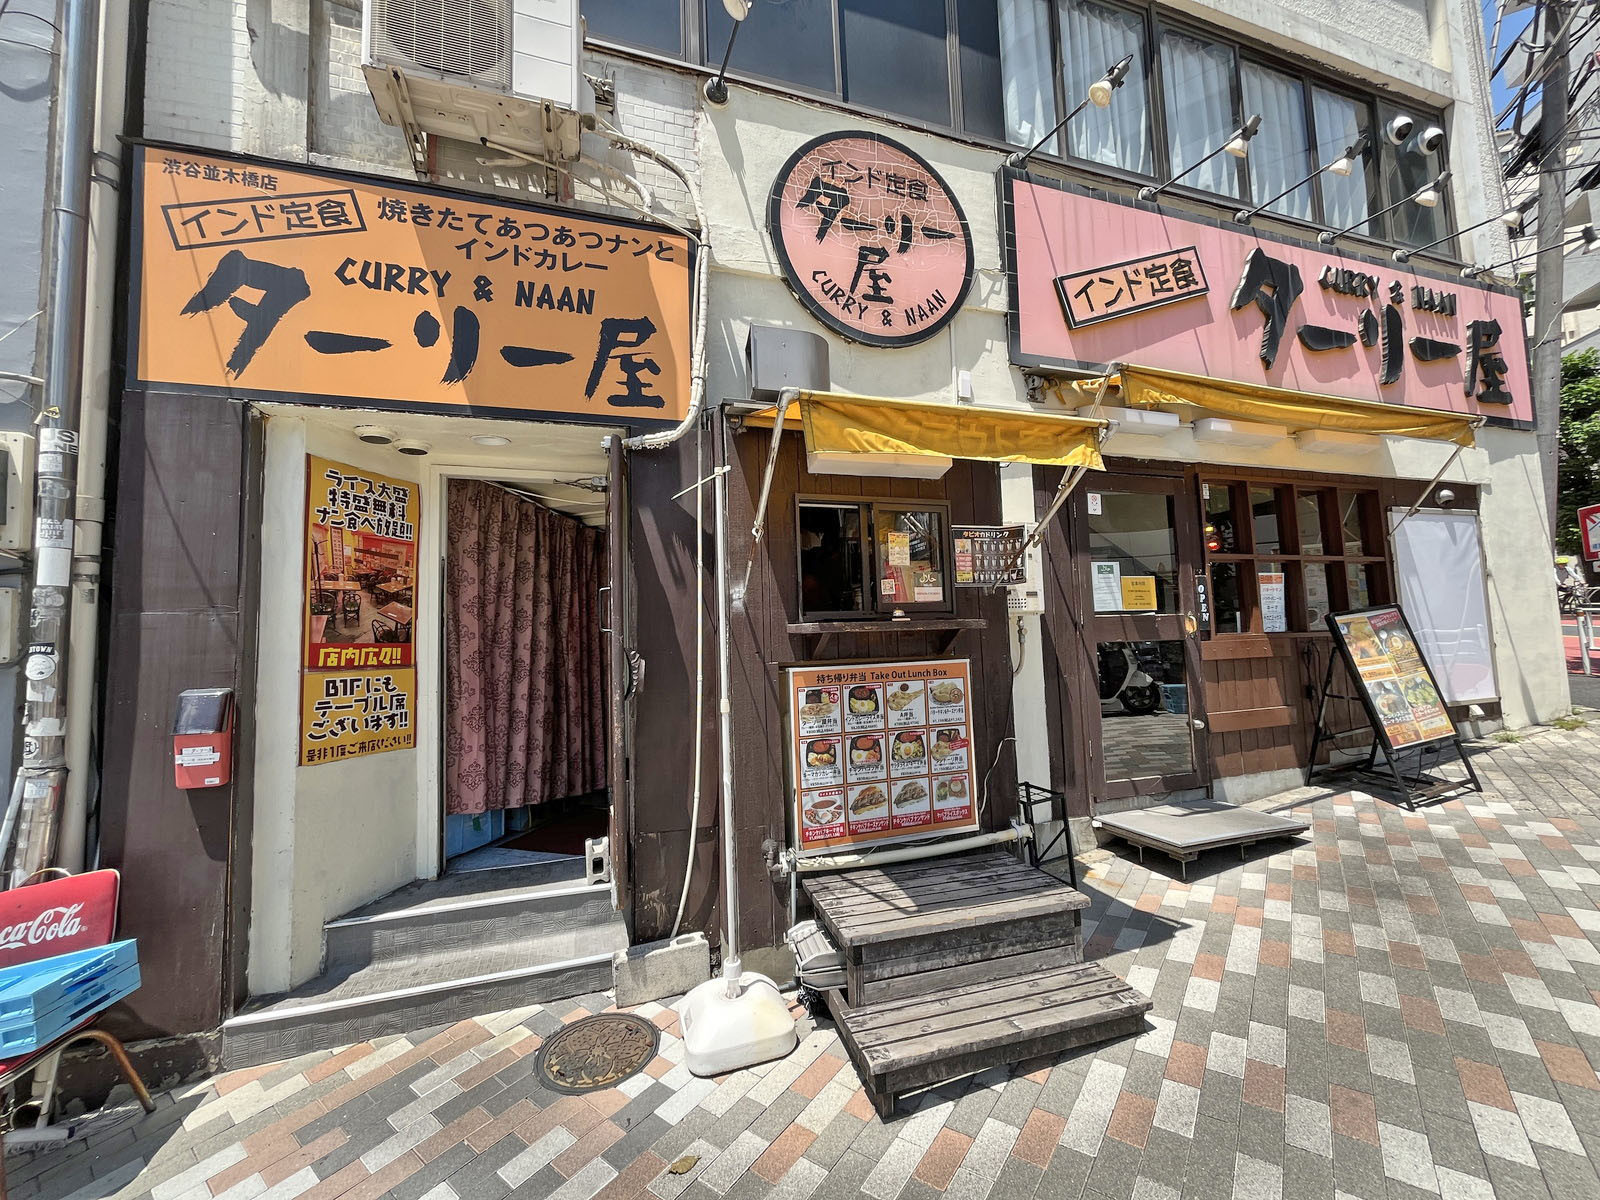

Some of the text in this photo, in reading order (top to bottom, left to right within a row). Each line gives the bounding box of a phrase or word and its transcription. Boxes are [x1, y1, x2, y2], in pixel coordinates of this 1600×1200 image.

[162, 157, 279, 191] 渋谷並木橋店
[822, 160, 928, 202] インド定食
[180, 199, 353, 239] インド定食
[378, 196, 675, 262] 焼きたてあつあつナンと
[796, 176, 957, 254] ターリー
[455, 238, 608, 272] インドカレー
[850, 246, 893, 304] 屋
[334, 257, 595, 315] CURRY & NAAN
[812, 270, 947, 326] CURRY & NAAN
[1073, 258, 1199, 312] インド定食
[1318, 265, 1380, 299] CURRY
[1411, 286, 1456, 316] NAAN
[180, 249, 666, 409] ターリー屋
[1230, 247, 1513, 405] ターリー屋
[325, 469, 409, 503] ライス大盛
[329, 488, 406, 521] 特盛無料
[316, 507, 413, 540] ナン食べ放題!!
[1198, 585, 1209, 622] OPEN
[318, 648, 401, 666] 店内広々!!
[816, 669, 947, 684] 持ち帰り弁当 Take Out Lunch Box
[315, 693, 407, 717] テーブル席
[325, 676, 397, 697] B1Fにも
[307, 711, 408, 740] ございます!!
[0, 902, 85, 949] ca-Cola
